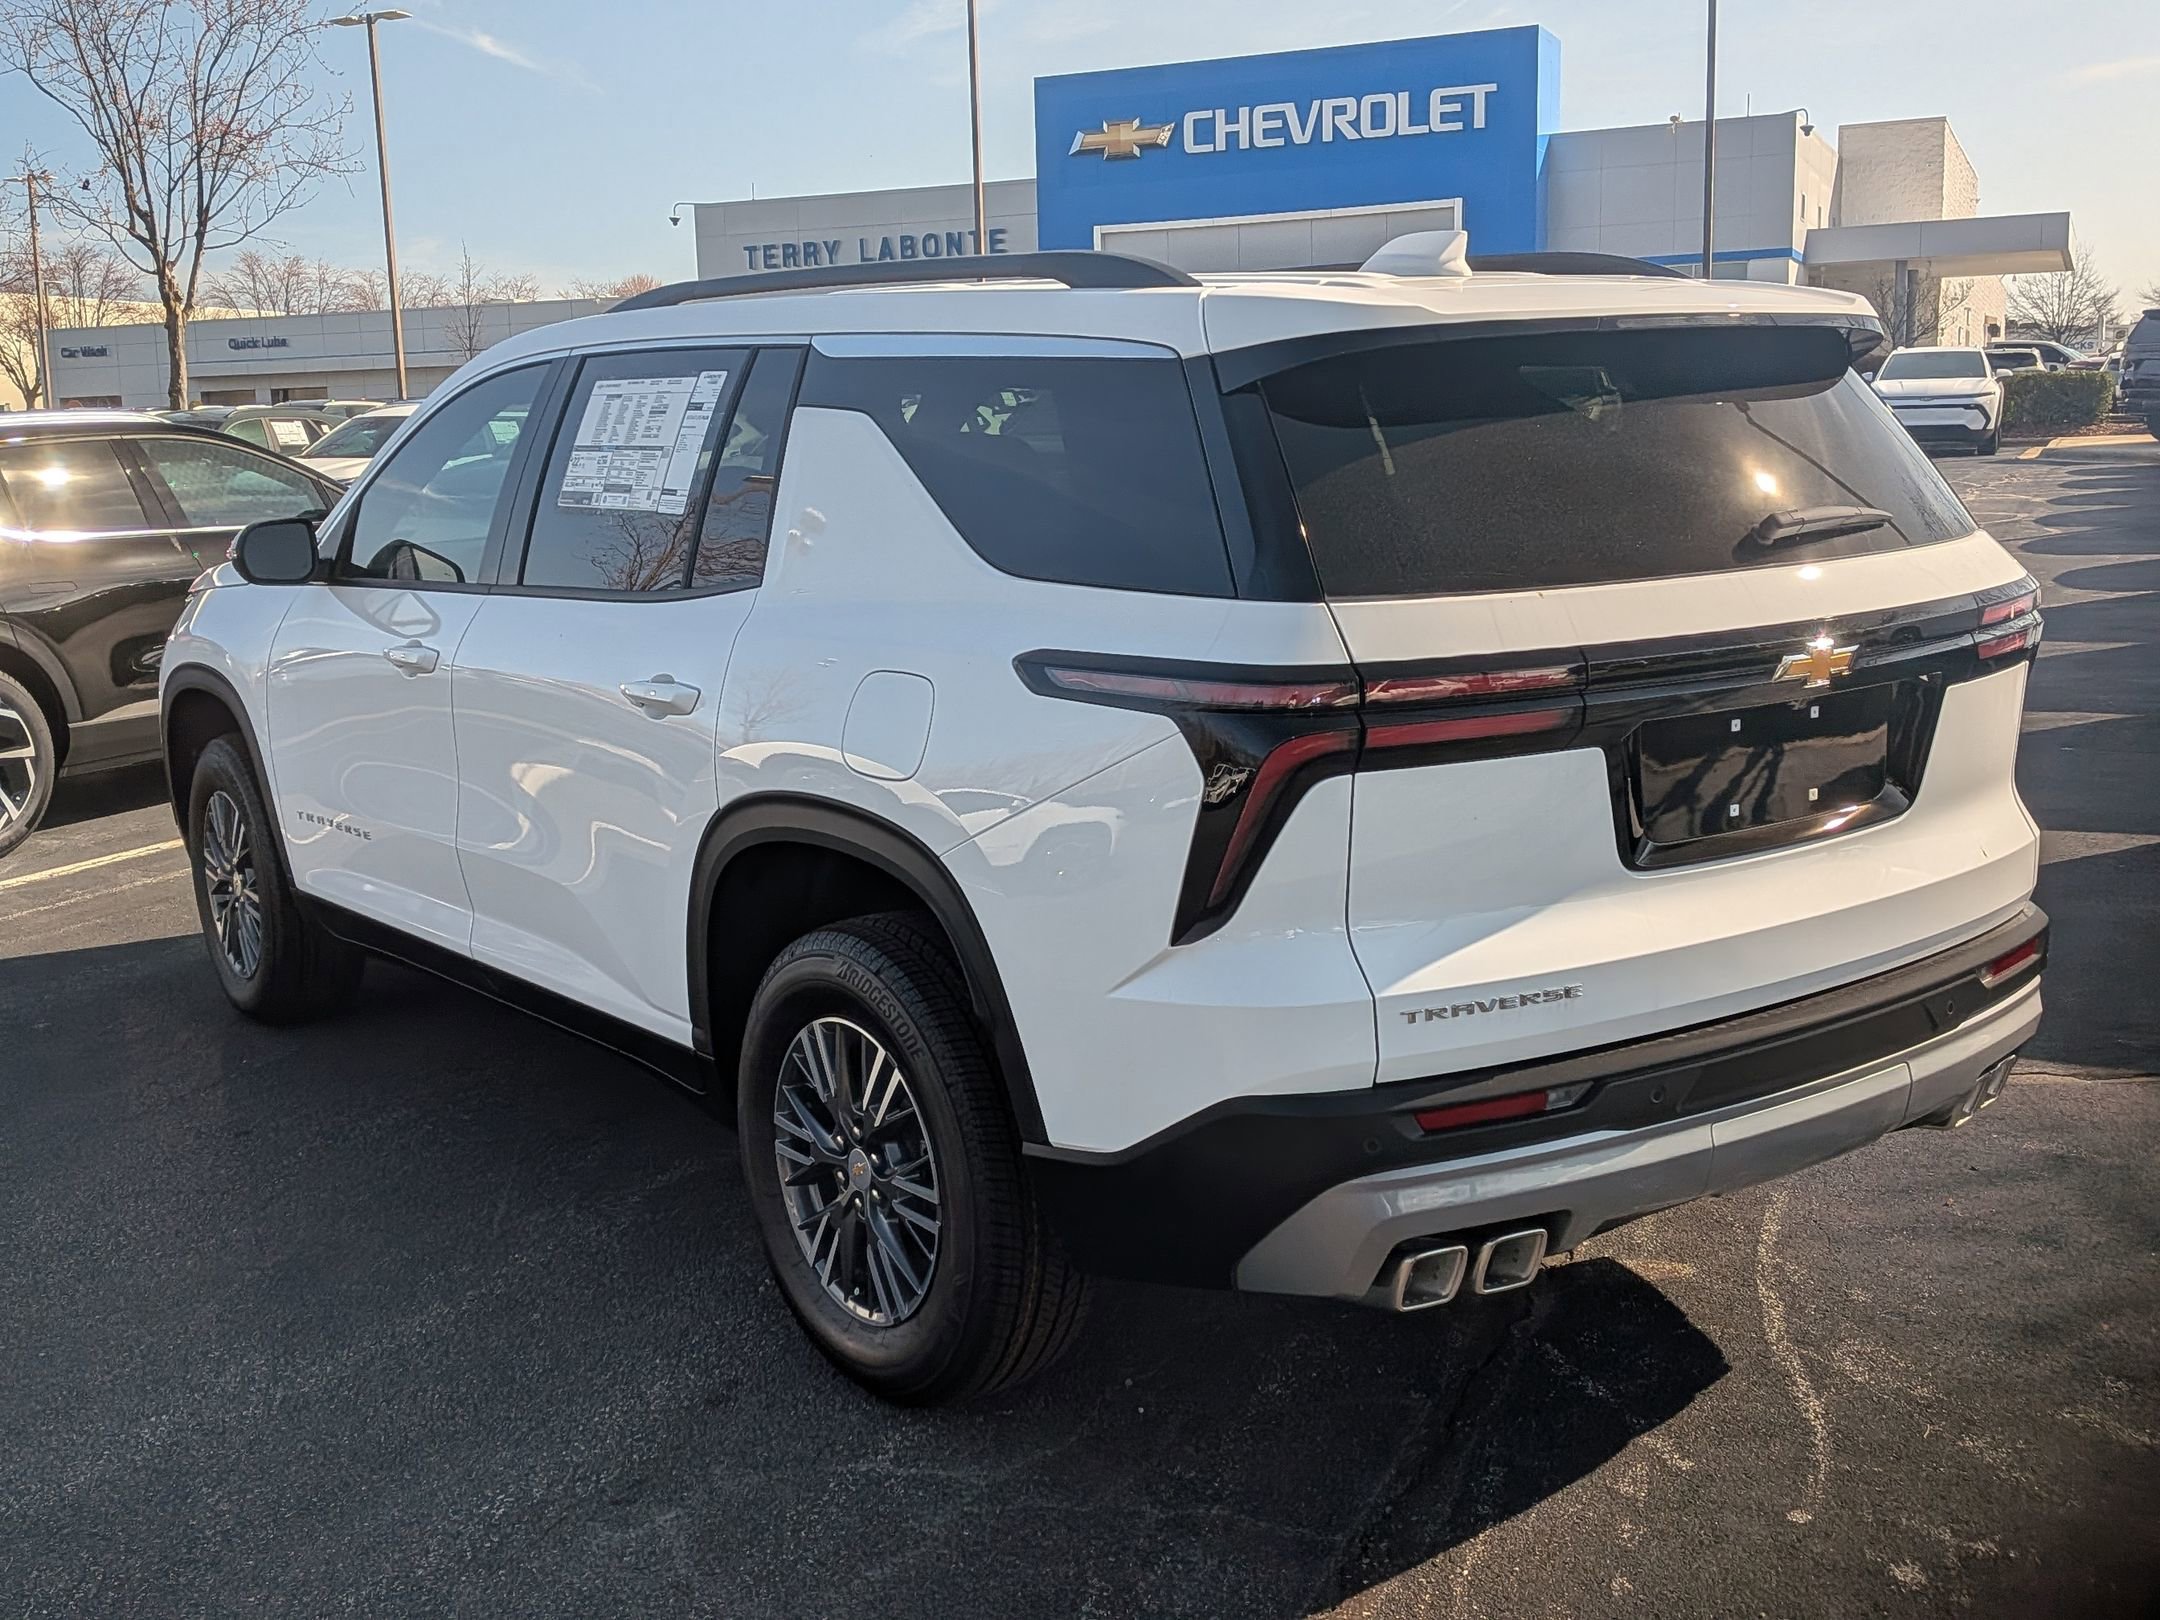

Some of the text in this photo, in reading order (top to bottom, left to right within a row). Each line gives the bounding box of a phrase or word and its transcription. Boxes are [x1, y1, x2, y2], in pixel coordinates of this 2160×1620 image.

[1183, 83, 1497, 154] CHEVROLET
[744, 239, 838, 271] TERRY
[60, 345, 107, 358] Car Wash
[228, 335, 288, 351] Quick Lube
[296, 811, 372, 840] TRAVERSE
[837, 961, 924, 1061] BRIDGESTONE
[1400, 983, 1584, 1024] TRAVERSE
